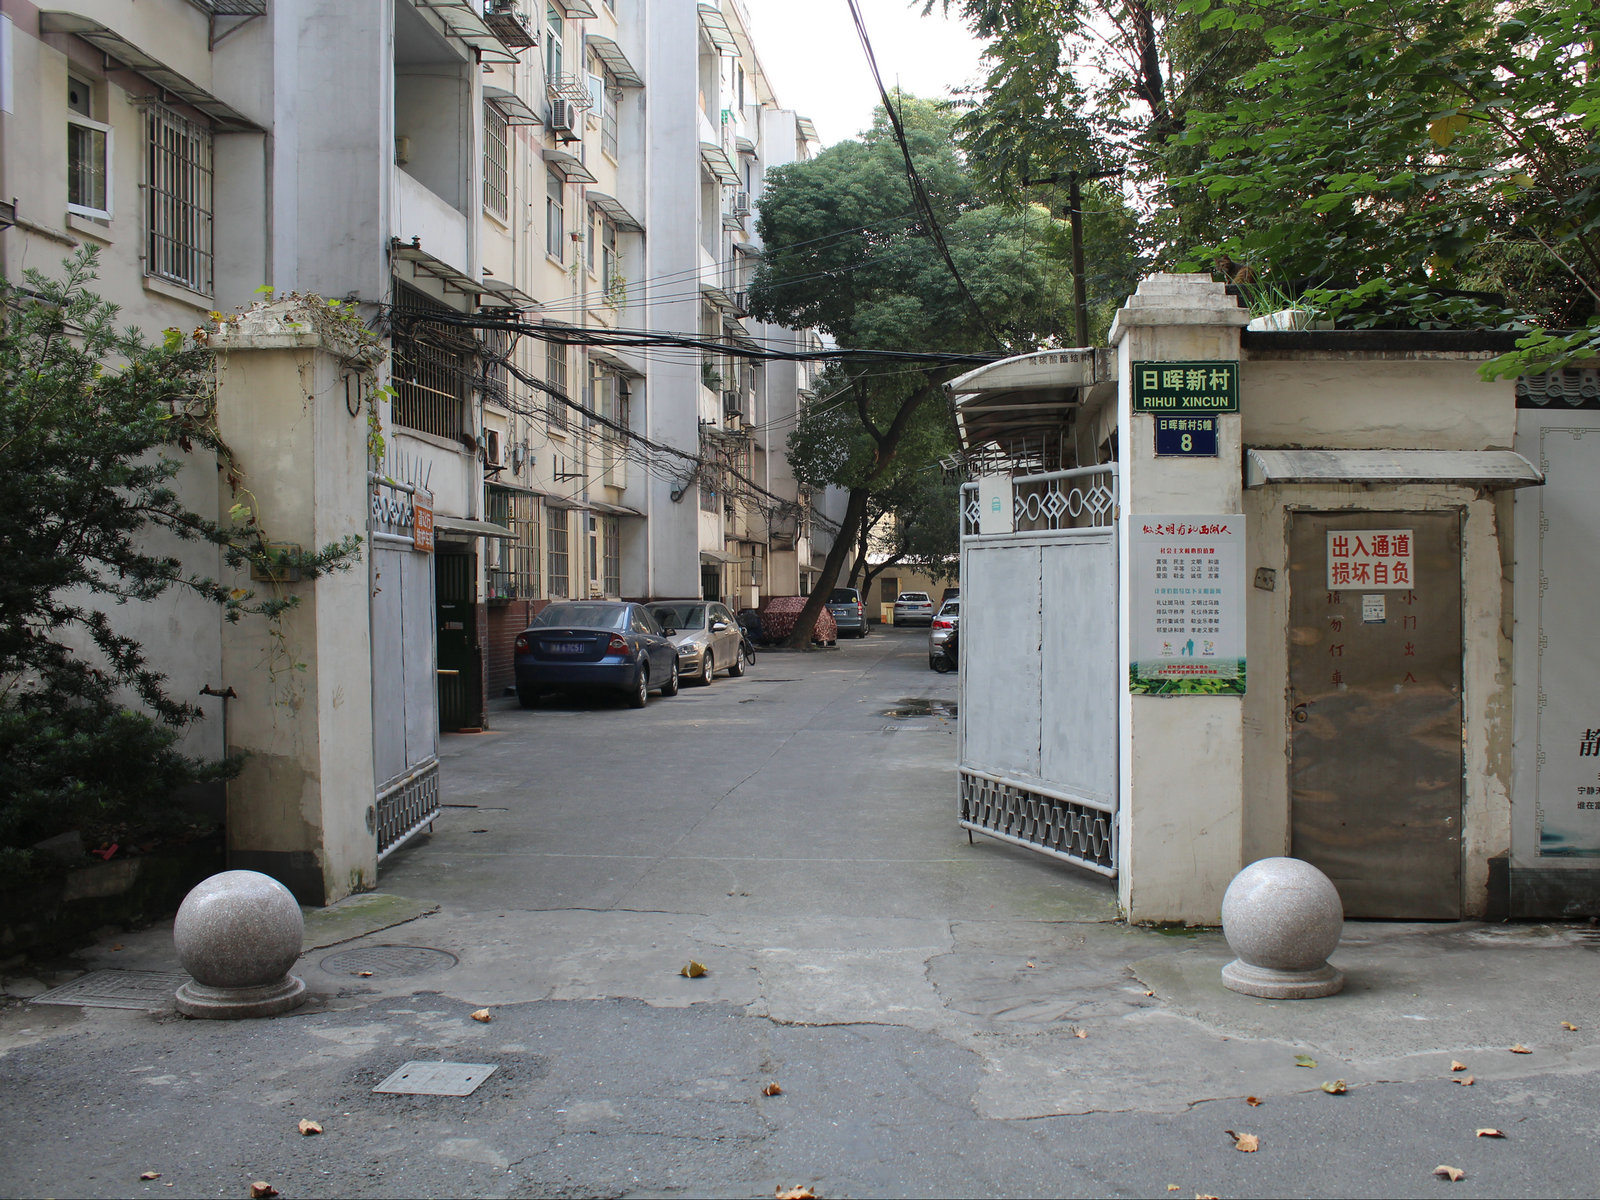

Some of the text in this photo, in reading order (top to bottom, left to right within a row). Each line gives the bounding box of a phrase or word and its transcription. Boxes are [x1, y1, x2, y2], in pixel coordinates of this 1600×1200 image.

[1143, 369, 1230, 391] 日晖新村
[1143, 396, 1229, 407] RIHUI XINCUN
[1160, 420, 1212, 431] 日晖新村5幢
[1181, 433, 1193, 452] 8
[1332, 534, 1410, 558] 出入通道
[1331, 561, 1410, 585] 损坏自负
[1403, 590, 1417, 683] 小门出入
